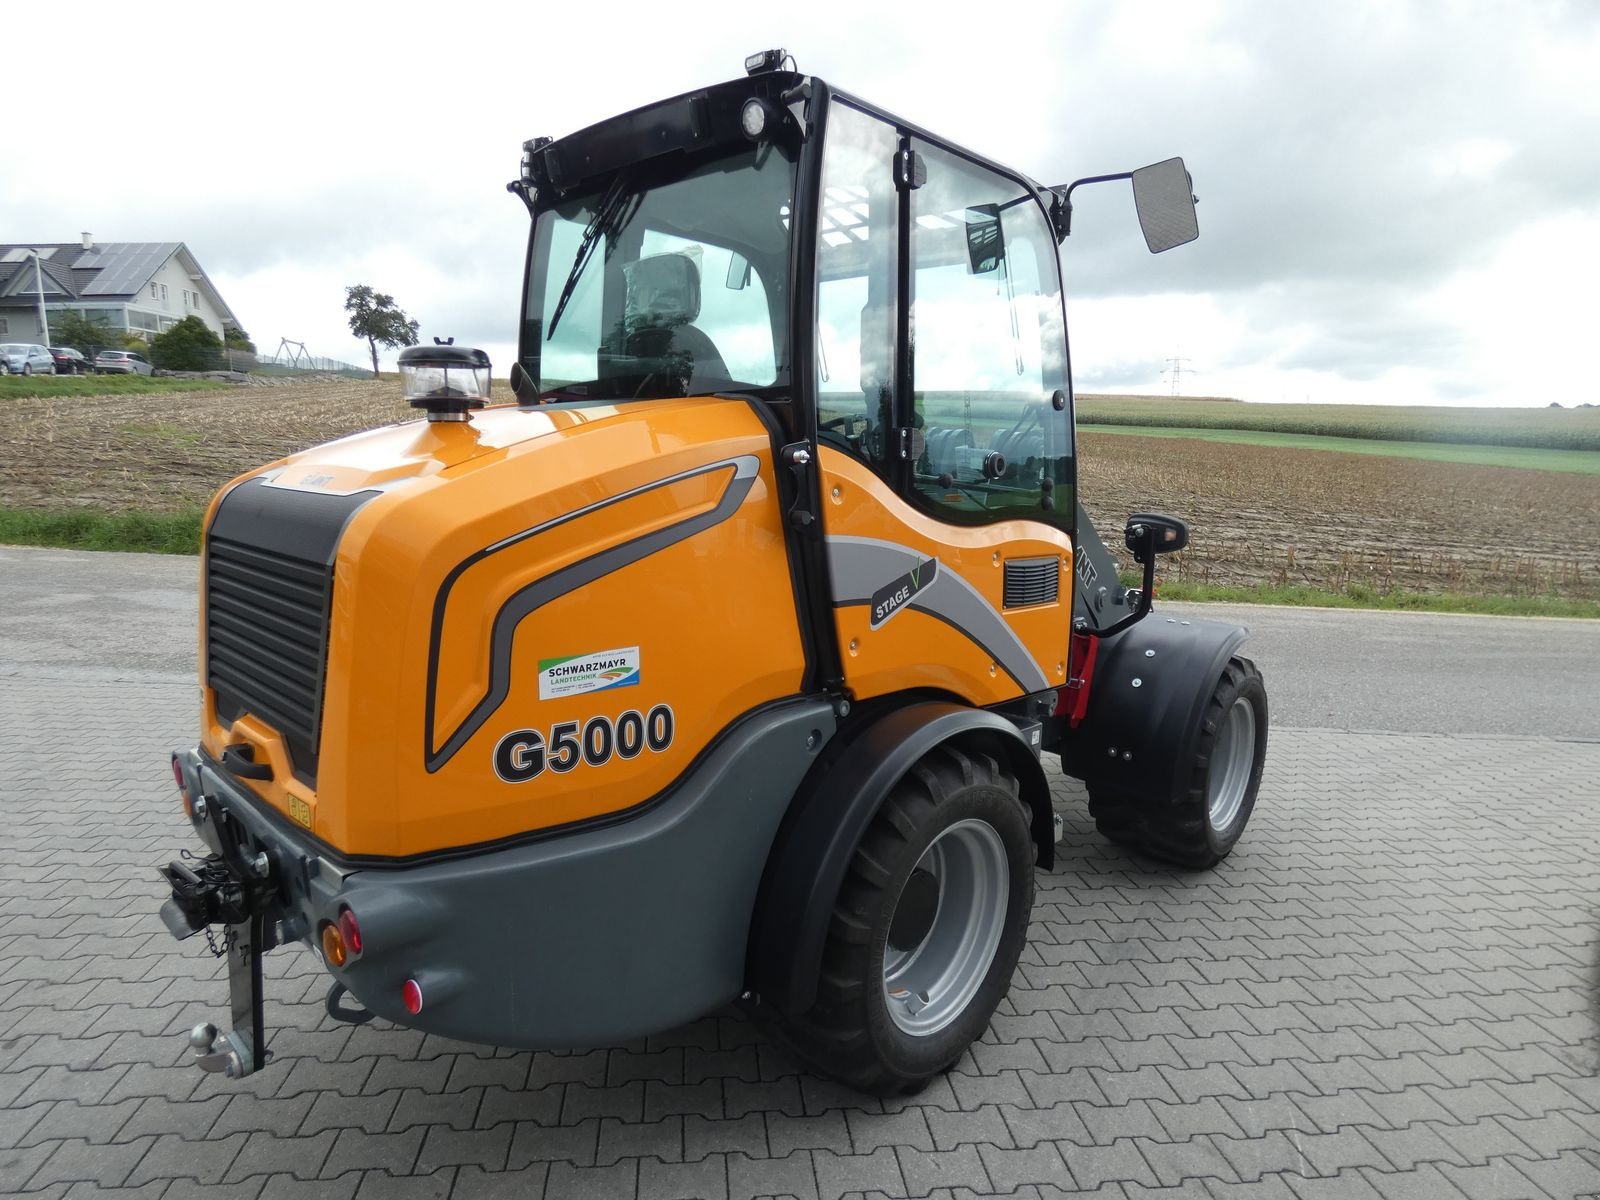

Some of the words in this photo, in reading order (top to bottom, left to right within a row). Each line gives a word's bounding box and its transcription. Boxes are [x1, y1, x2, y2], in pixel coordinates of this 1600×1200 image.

[876, 585, 910, 619] STAGE
[548, 658, 626, 678] SCHWARZMAYR
[550, 673, 597, 685] LANDTECHNIK
[493, 703, 675, 784] G5000
